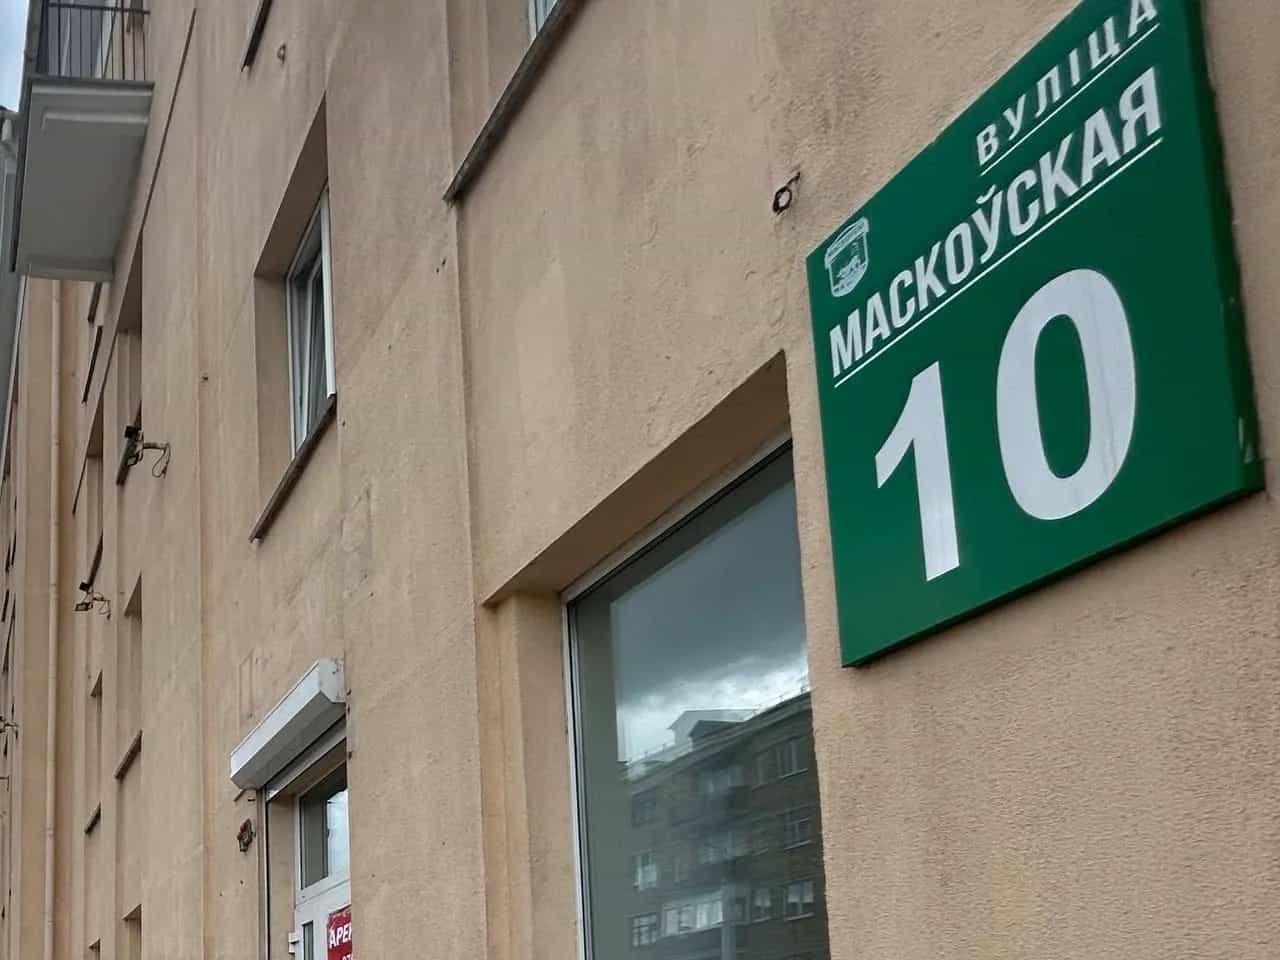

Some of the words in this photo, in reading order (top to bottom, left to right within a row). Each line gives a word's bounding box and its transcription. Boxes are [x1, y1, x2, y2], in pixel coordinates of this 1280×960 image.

[829, 66, 1162, 378] МАСКОЎСКАЯ
[976, 0, 1158, 167] ВУЛІЦА
[875, 268, 1136, 582] 10
